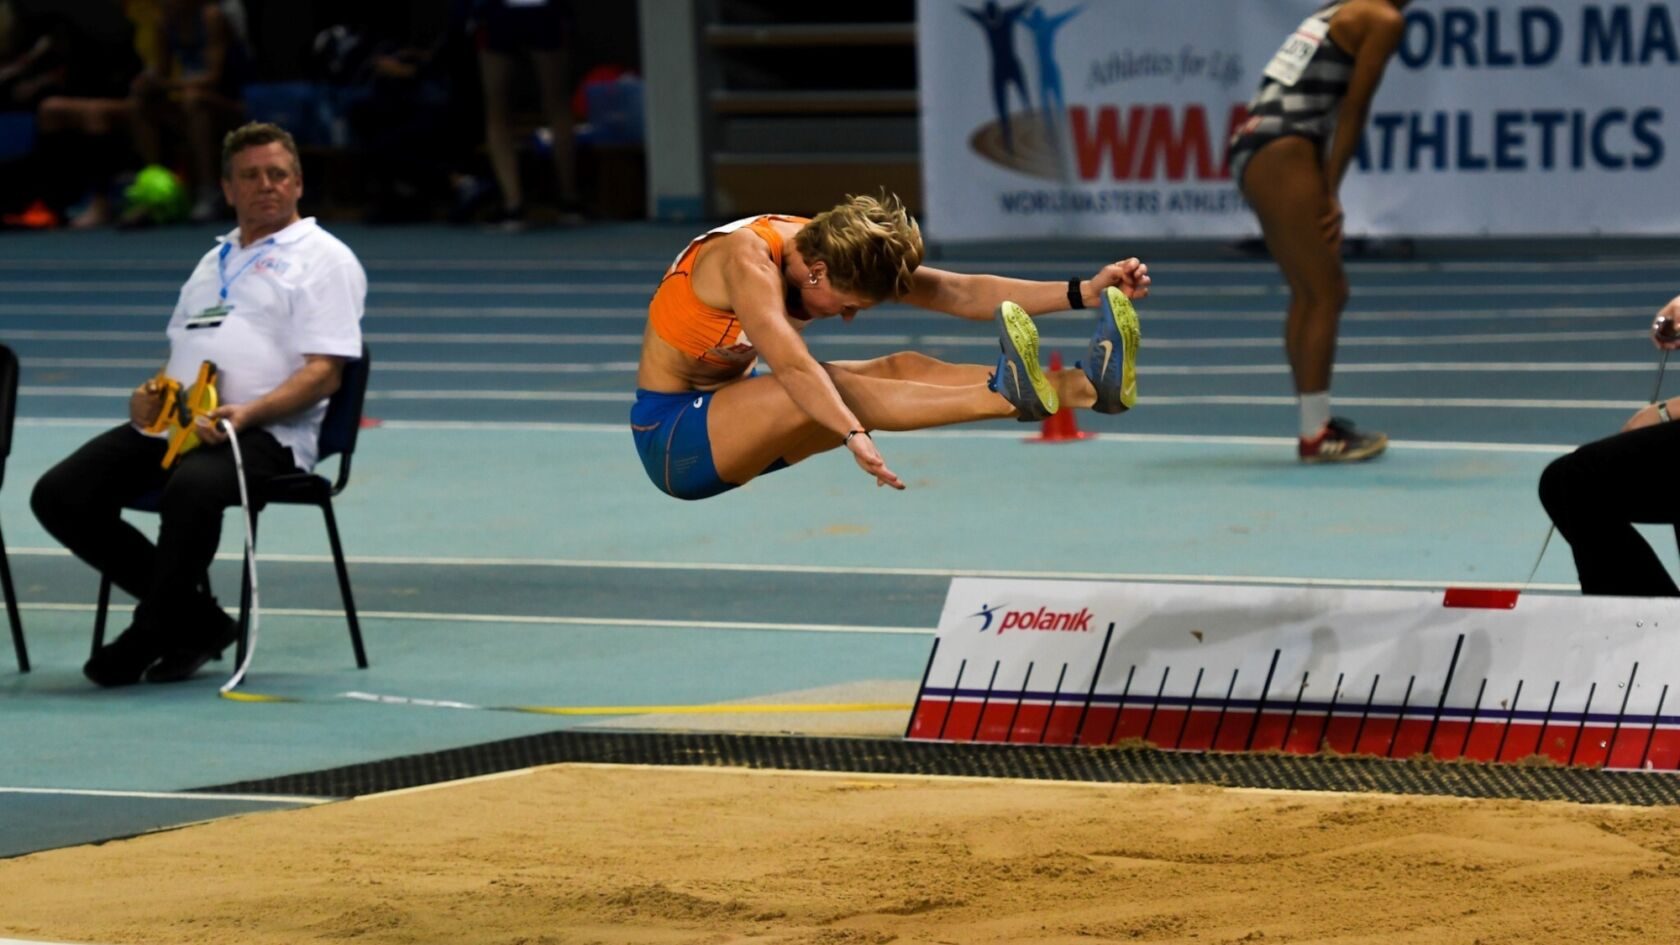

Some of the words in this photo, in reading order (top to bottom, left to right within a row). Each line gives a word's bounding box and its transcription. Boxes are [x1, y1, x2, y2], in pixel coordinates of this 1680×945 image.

[1398, 6, 1563, 69] ORLD
[1579, 3, 1680, 67] MA
[997, 606, 1093, 635] polanik
